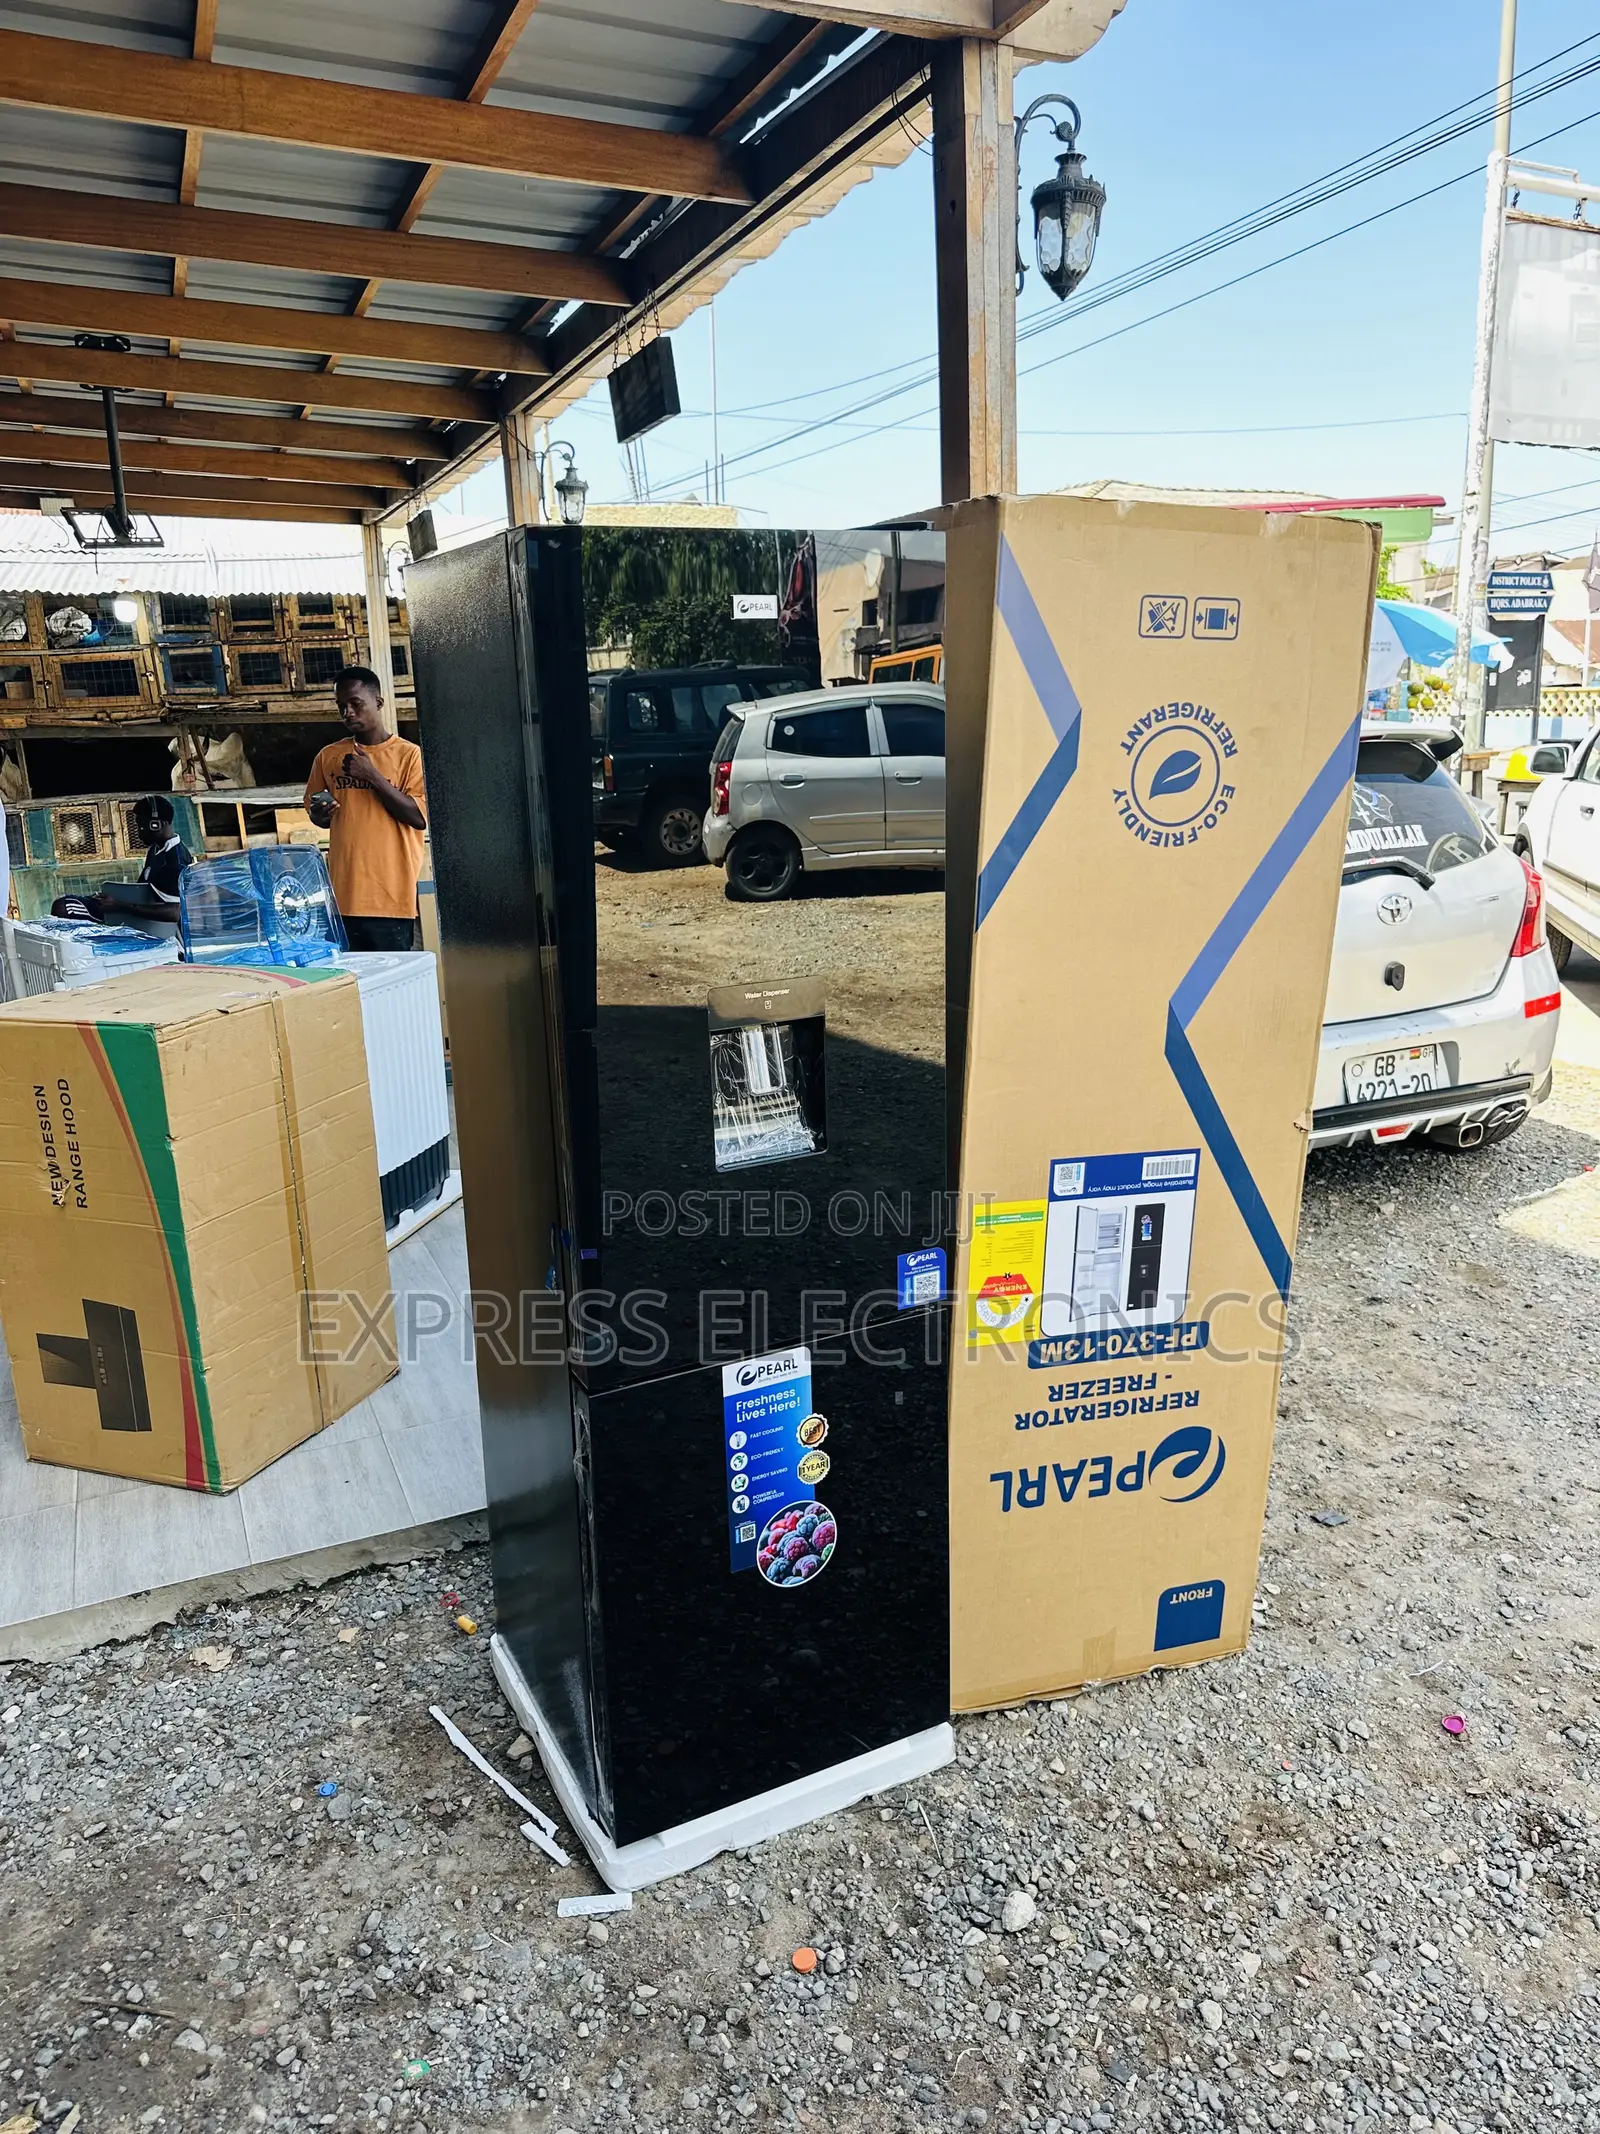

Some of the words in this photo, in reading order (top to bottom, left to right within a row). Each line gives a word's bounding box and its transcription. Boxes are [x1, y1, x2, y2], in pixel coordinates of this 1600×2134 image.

[1491, 575, 1520, 586] DISTRICT
[1520, 576, 1542, 586] POLICE
[749, 603, 773, 611] PEARL
[1510, 598, 1548, 609] ADABRAKA
[1120, 702, 1239, 759] REFRIGERANT
[1112, 784, 1236, 848] ECO-FRIENDLY
[762, 988, 790, 997] Dispenser
[1422, 1046, 1434, 1058] GH
[1374, 1054, 1396, 1077] GB
[57, 1078, 77, 1135] HOOD
[33, 1085, 57, 1158] DESIGN
[68, 1141, 88, 1208] RANGE
[1164, 1179, 1194, 1187] Illustrative
[47, 1162, 64, 1207] NEW
[1117, 1183, 1141, 1191] product
[917, 1252, 938, 1262] PEARL
[993, 1283, 1028, 1293] ENERGY
[1040, 1325, 1198, 1364] PF-370-13M
[757, 1358, 798, 1378] PEARL
[1048, 1373, 1158, 1402] FREEZER
[736, 1388, 796, 1411] Freshness
[736, 1408, 766, 1423] Lives
[769, 1396, 801, 1415] Here!
[1014, 1390, 1200, 1431] REFRIGERATOR
[750, 1431, 761, 1439] FAST
[762, 1425, 784, 1436] COOLING
[804, 1422, 821, 1437] BEST
[750, 1446, 784, 1460] ECO-FRIENDLY
[752, 1472, 769, 1481] ENERGY
[770, 1467, 788, 1476] SAVING
[806, 1461, 826, 1473] YEAR
[990, 1450, 1147, 1512] PEARL
[1170, 1586, 1213, 1605] FRONT
